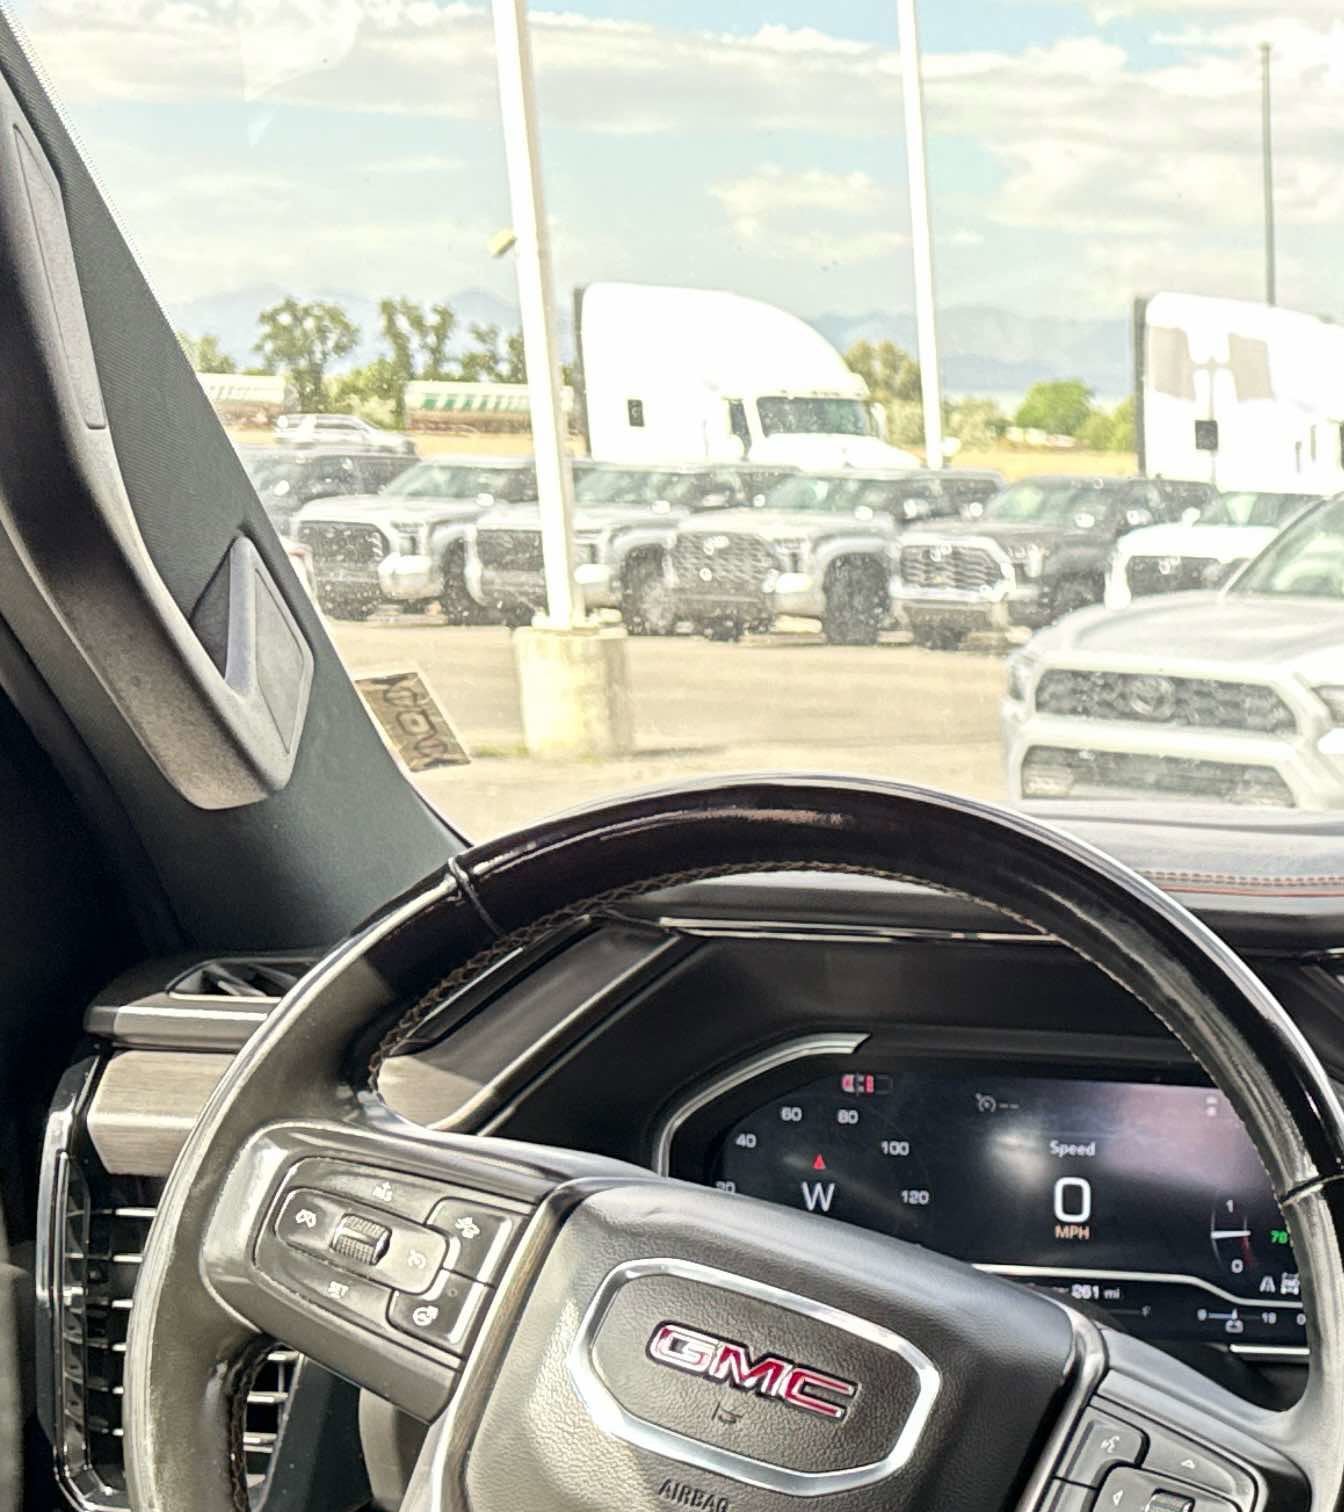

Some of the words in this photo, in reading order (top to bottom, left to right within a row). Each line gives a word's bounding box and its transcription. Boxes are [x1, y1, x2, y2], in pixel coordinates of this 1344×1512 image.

[781, 1106, 802, 1122] 60
[837, 1109, 859, 1124] 80
[736, 1133, 757, 1148] 40
[881, 1141, 910, 1156] 100
[1050, 1140, 1096, 1157] Speed
[802, 1181, 836, 1212] W
[901, 1190, 929, 1205] 120
[1053, 1176, 1092, 1223] 0
[1055, 1225, 1091, 1240] MPH
[648, 1321, 858, 1420] GMC
